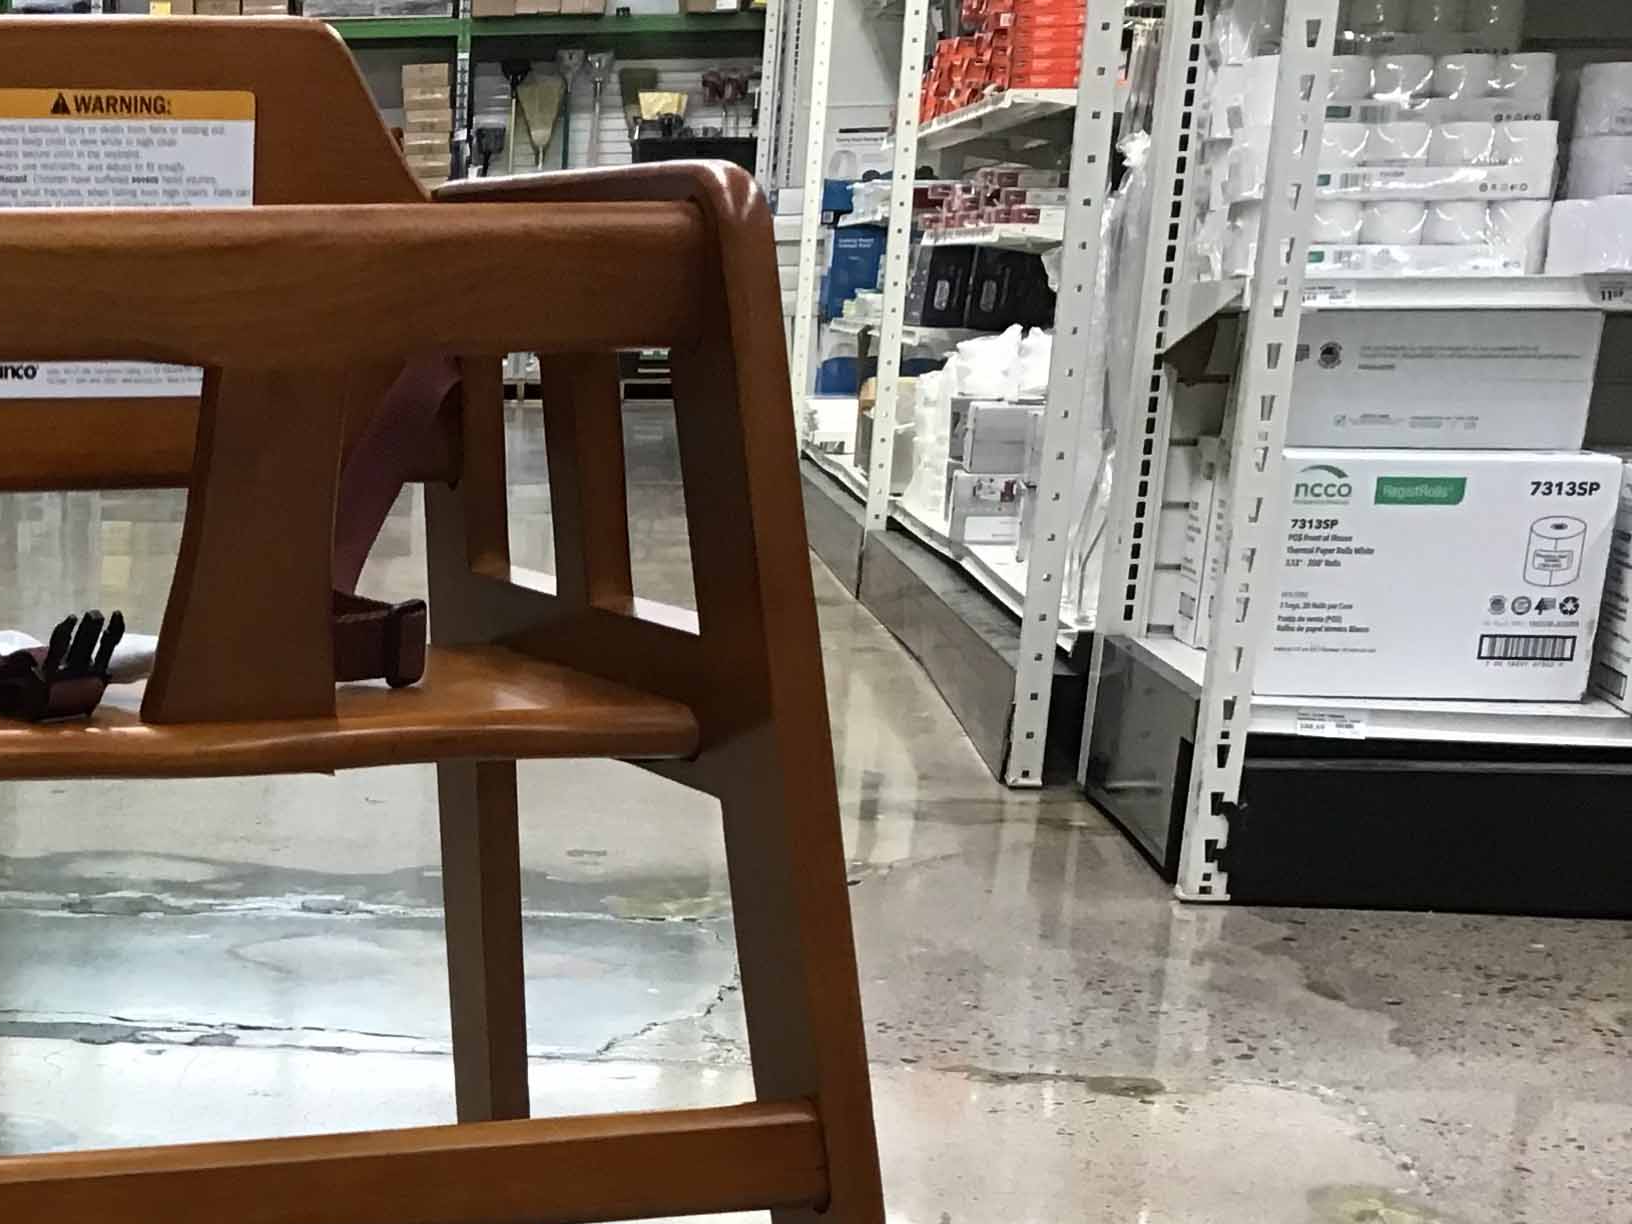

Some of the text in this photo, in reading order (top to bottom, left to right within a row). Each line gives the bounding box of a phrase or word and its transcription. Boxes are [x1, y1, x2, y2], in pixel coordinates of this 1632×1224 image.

[73, 95, 171, 115] WARNING:
[1295, 482, 1353, 498] ncco
[1530, 481, 1601, 497] 7313SP
[1291, 518, 1339, 530] 7313SP
